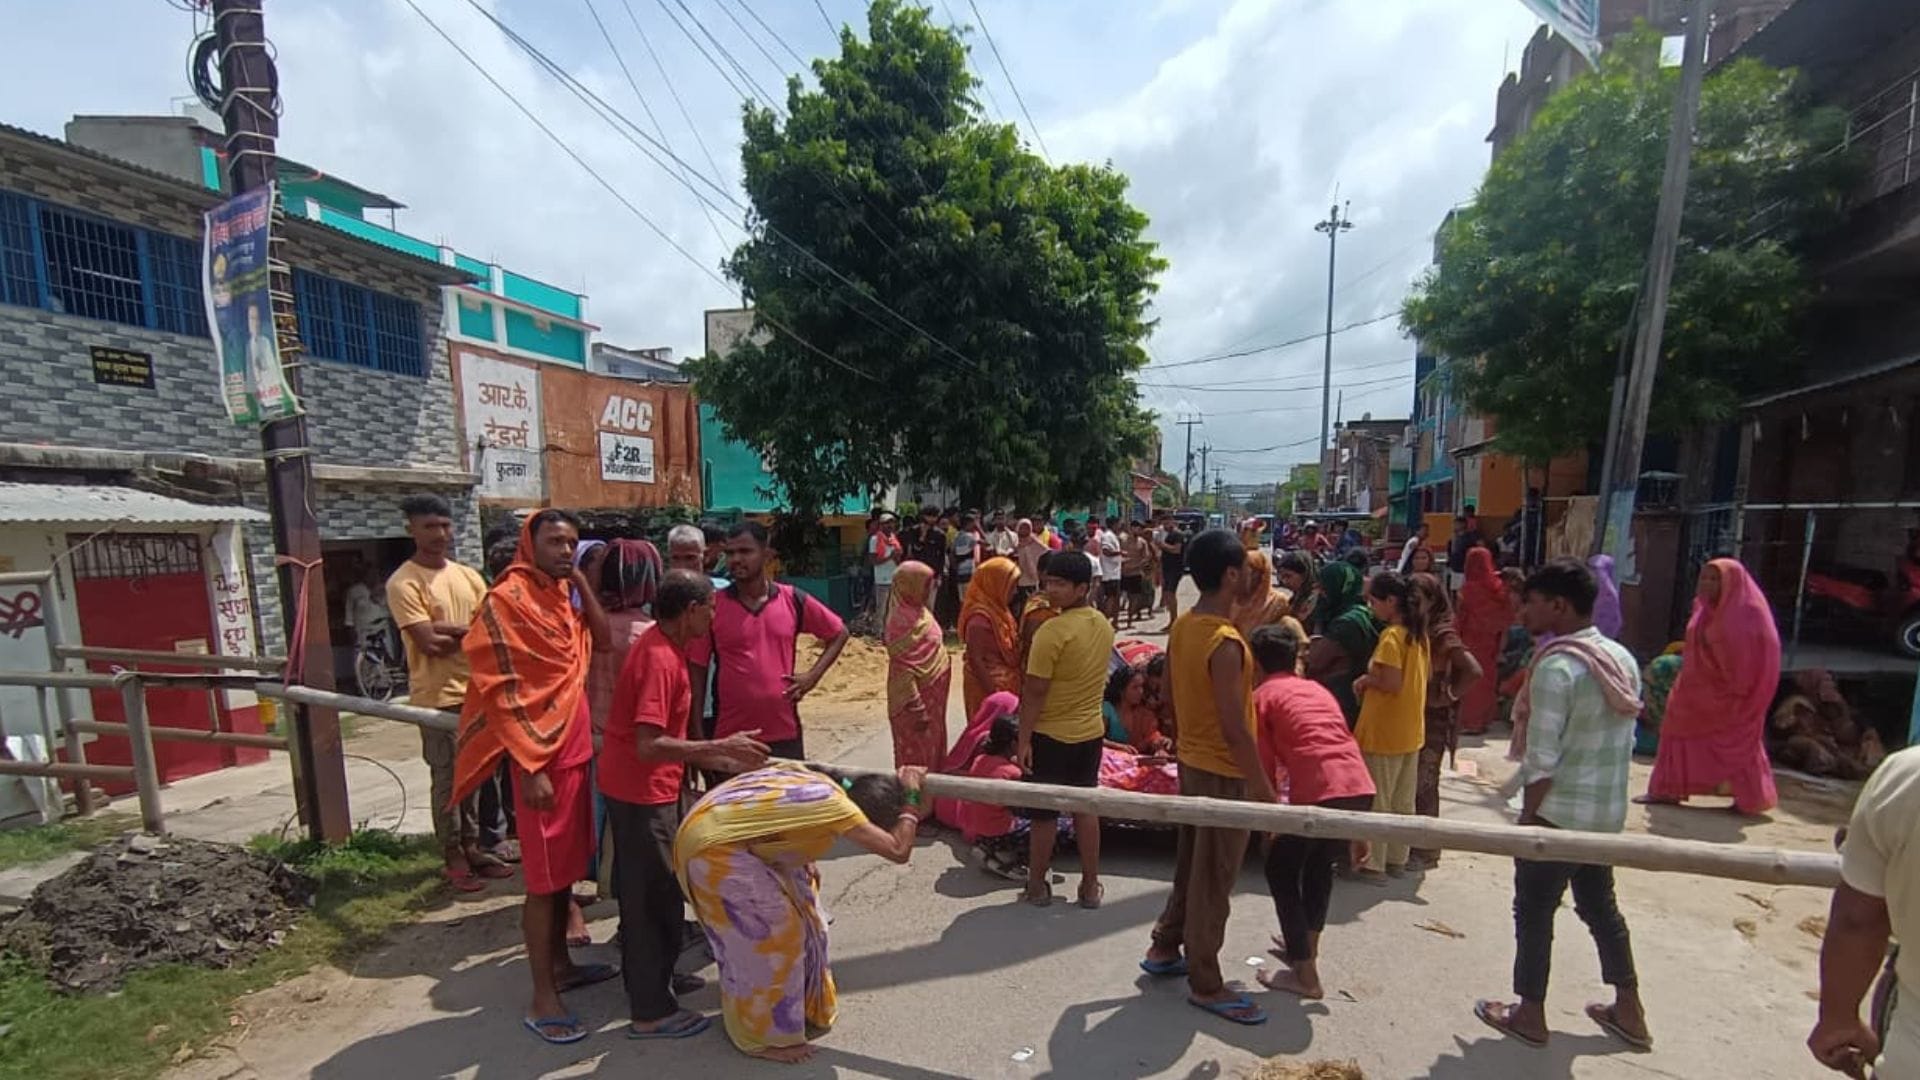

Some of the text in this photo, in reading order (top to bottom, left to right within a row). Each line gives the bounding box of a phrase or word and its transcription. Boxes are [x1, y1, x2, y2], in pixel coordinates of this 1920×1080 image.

[601, 394, 654, 433] ACC
[615, 442, 641, 463] F2R
[495, 462, 527, 482] फुलका
[217, 598, 249, 623] सुधा
